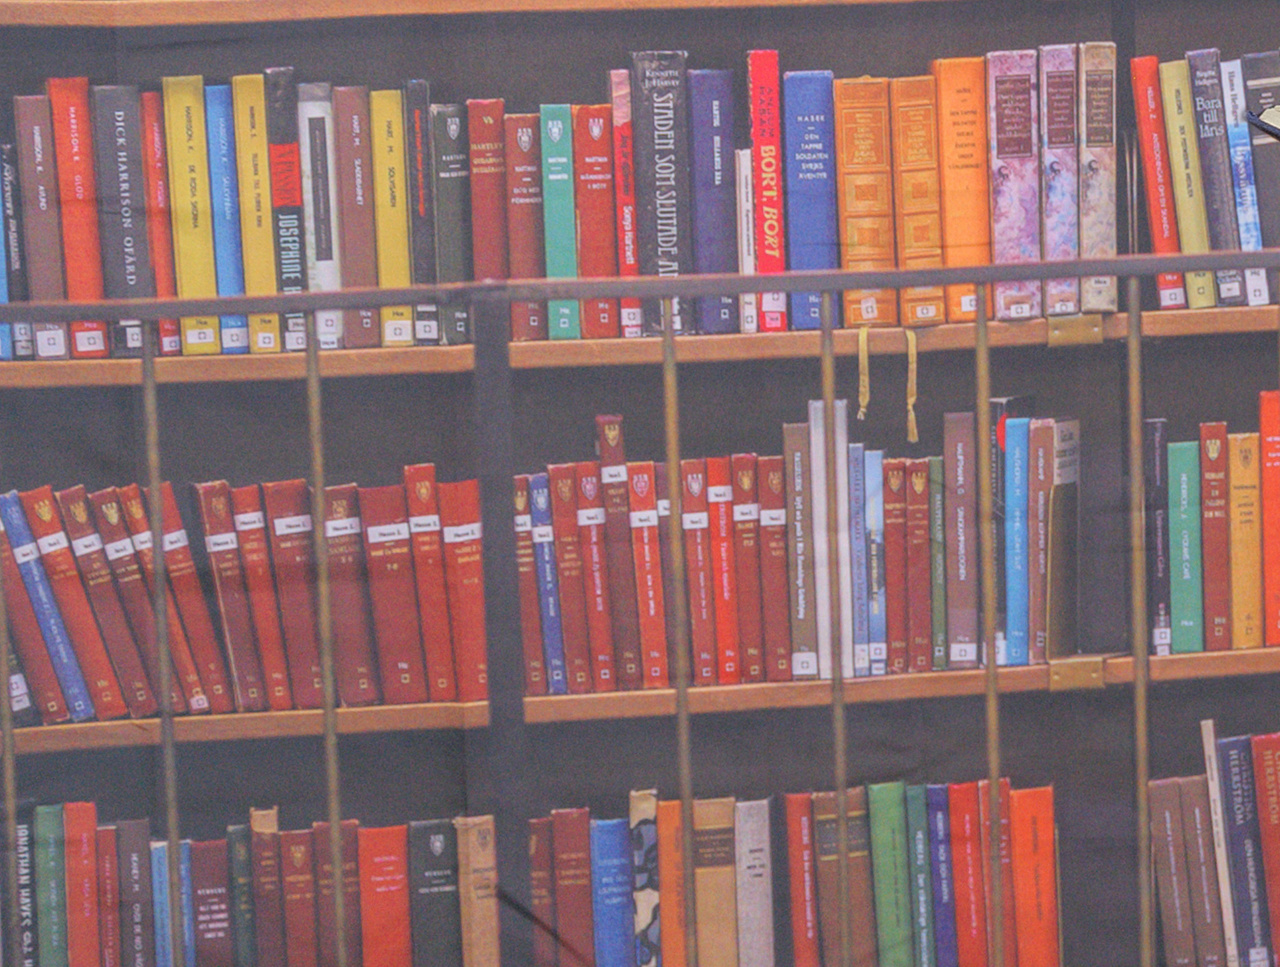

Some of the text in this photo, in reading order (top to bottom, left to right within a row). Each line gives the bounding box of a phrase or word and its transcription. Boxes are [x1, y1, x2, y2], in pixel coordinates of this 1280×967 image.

[113, 111, 127, 146] DICK
[652, 92, 676, 150] STADEN
[1195, 97, 1222, 110] Bara
[1203, 111, 1218, 123] till
[116, 151, 133, 229] HARRISON
[654, 154, 677, 186] SOM
[280, 214, 302, 280] JOSEPHINE
[624, 231, 636, 265] Hartnett
[655, 190, 678, 255] SLUTADE
[762, 205, 780, 258] BORT
[16, 825, 31, 884] JONATHAN
